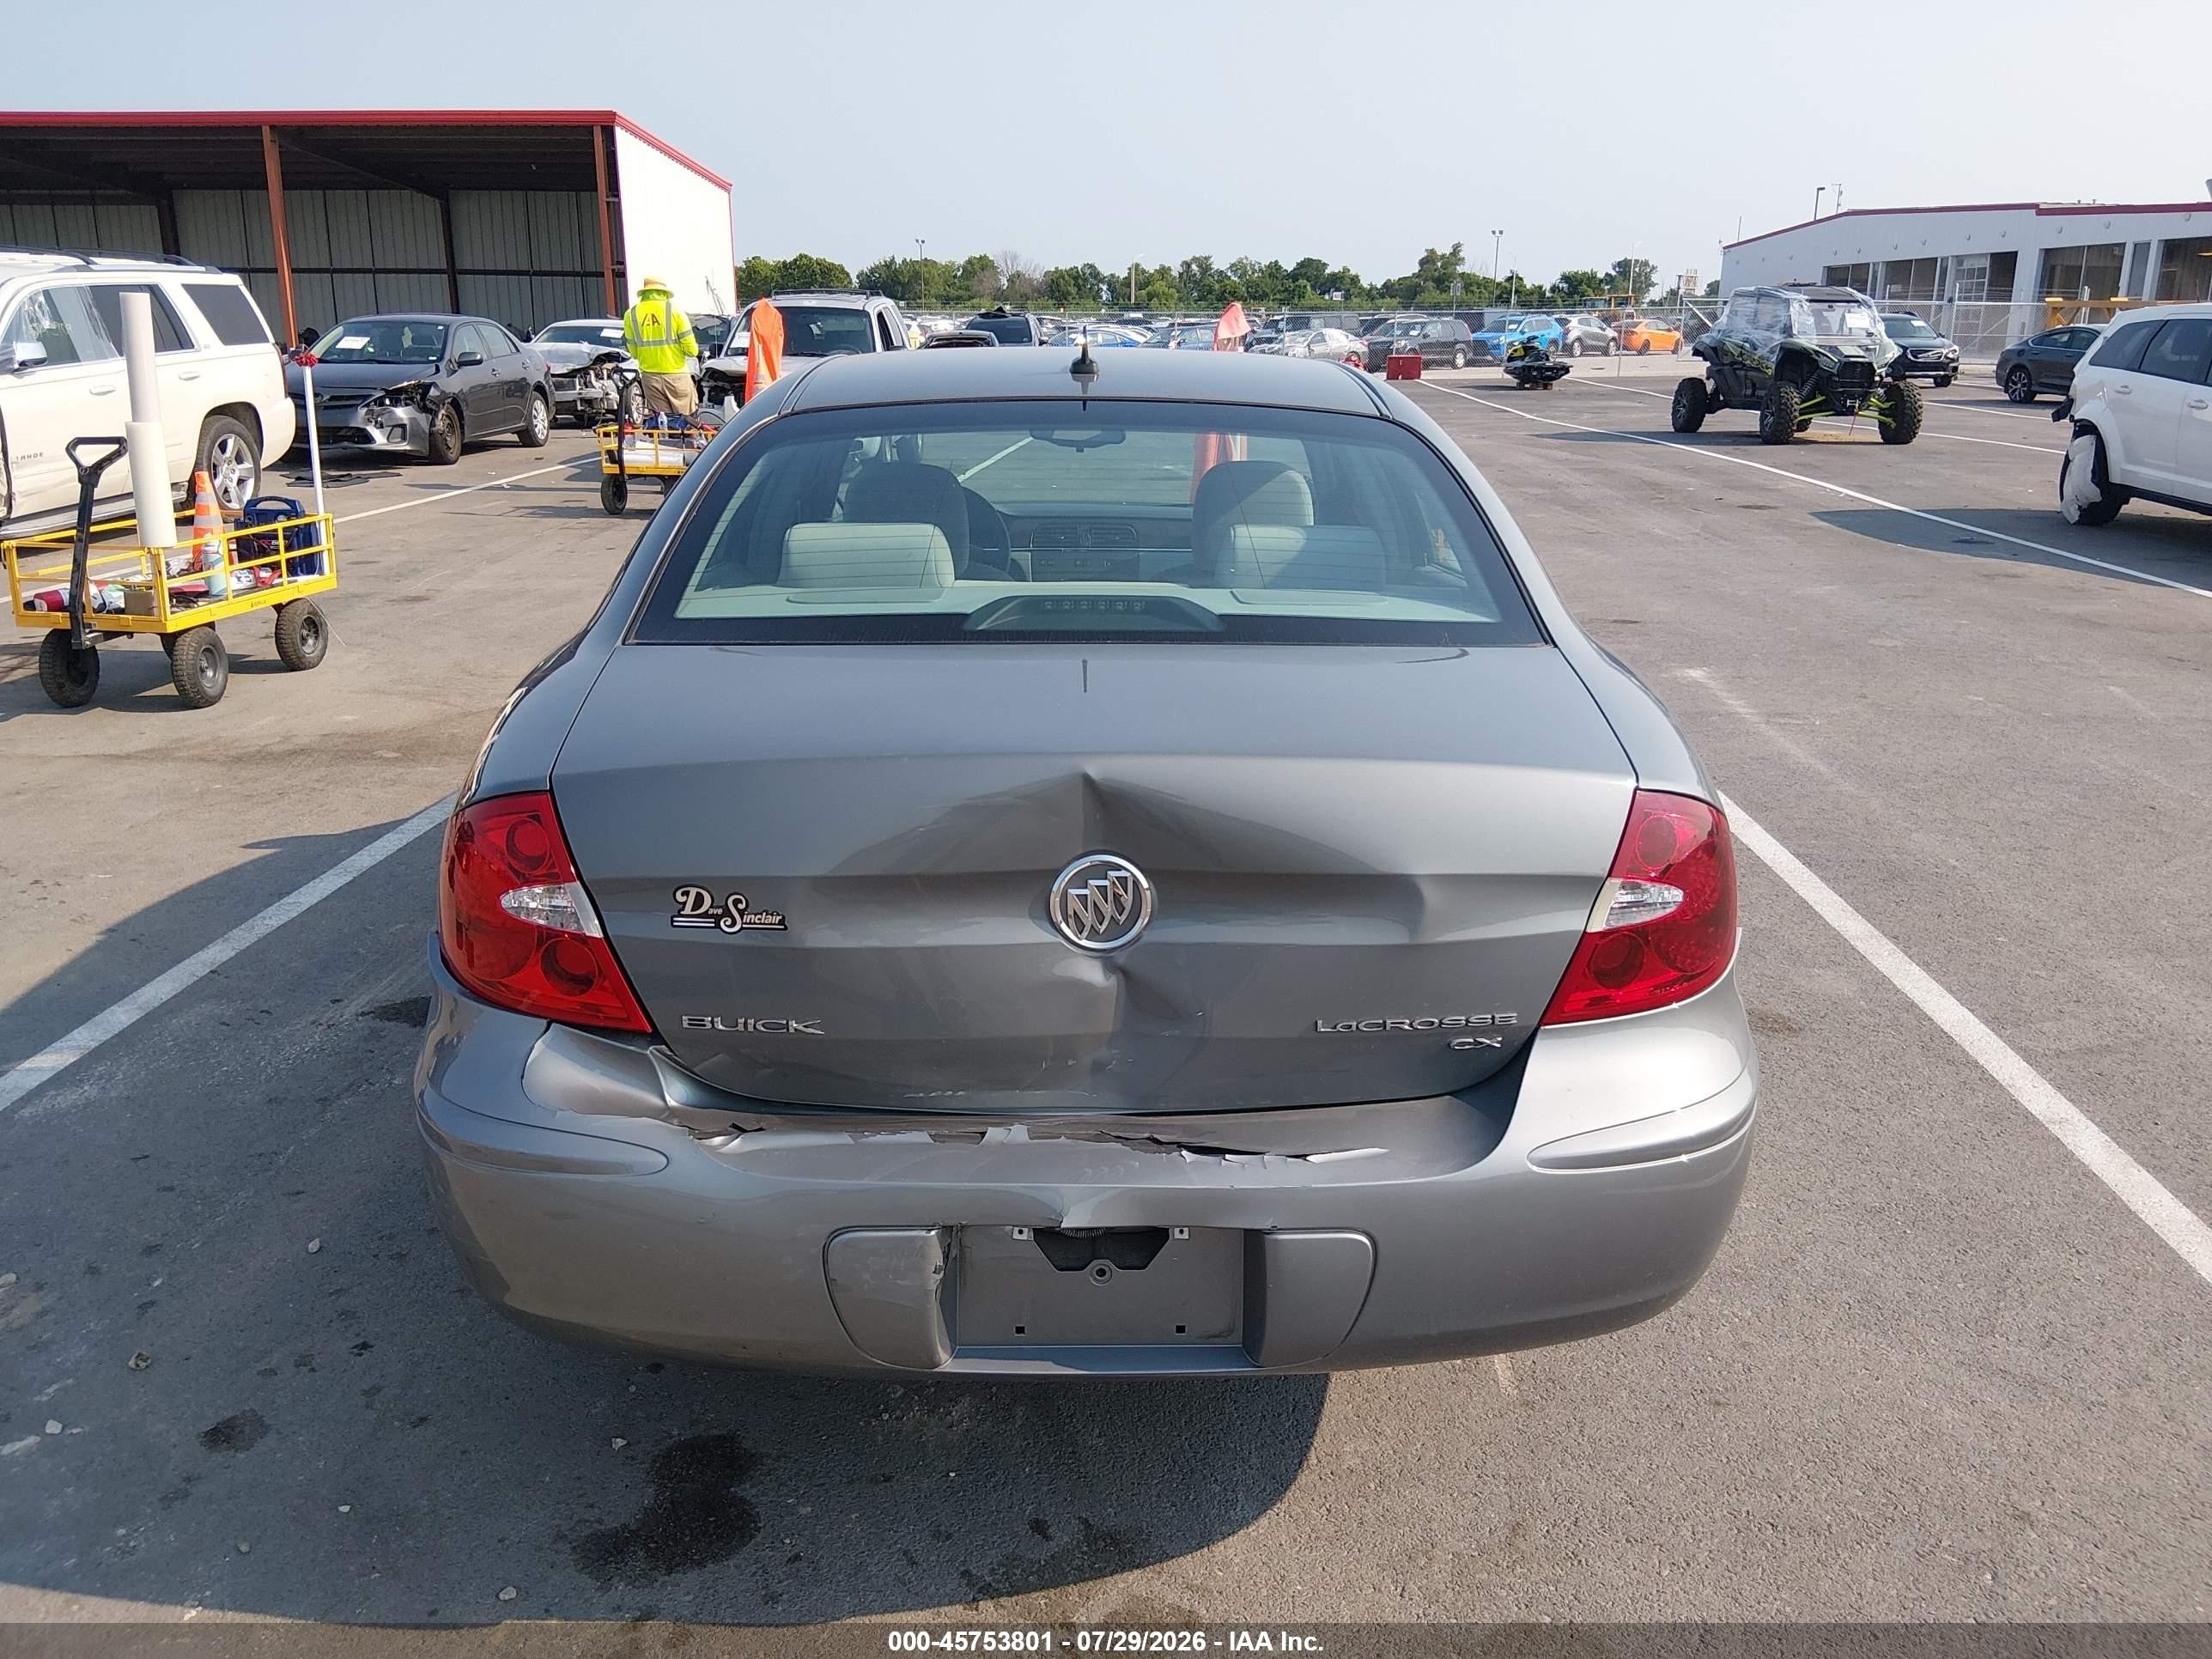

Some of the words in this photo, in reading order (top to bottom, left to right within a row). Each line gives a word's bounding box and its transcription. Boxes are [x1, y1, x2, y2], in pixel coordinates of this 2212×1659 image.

[675, 886, 723, 915] Dave
[720, 894, 783, 933] Sinclair
[682, 1015, 825, 1035] BUICK
[1316, 1012, 1518, 1033] LaCROSSE
[1449, 1036, 1504, 1050] CX
